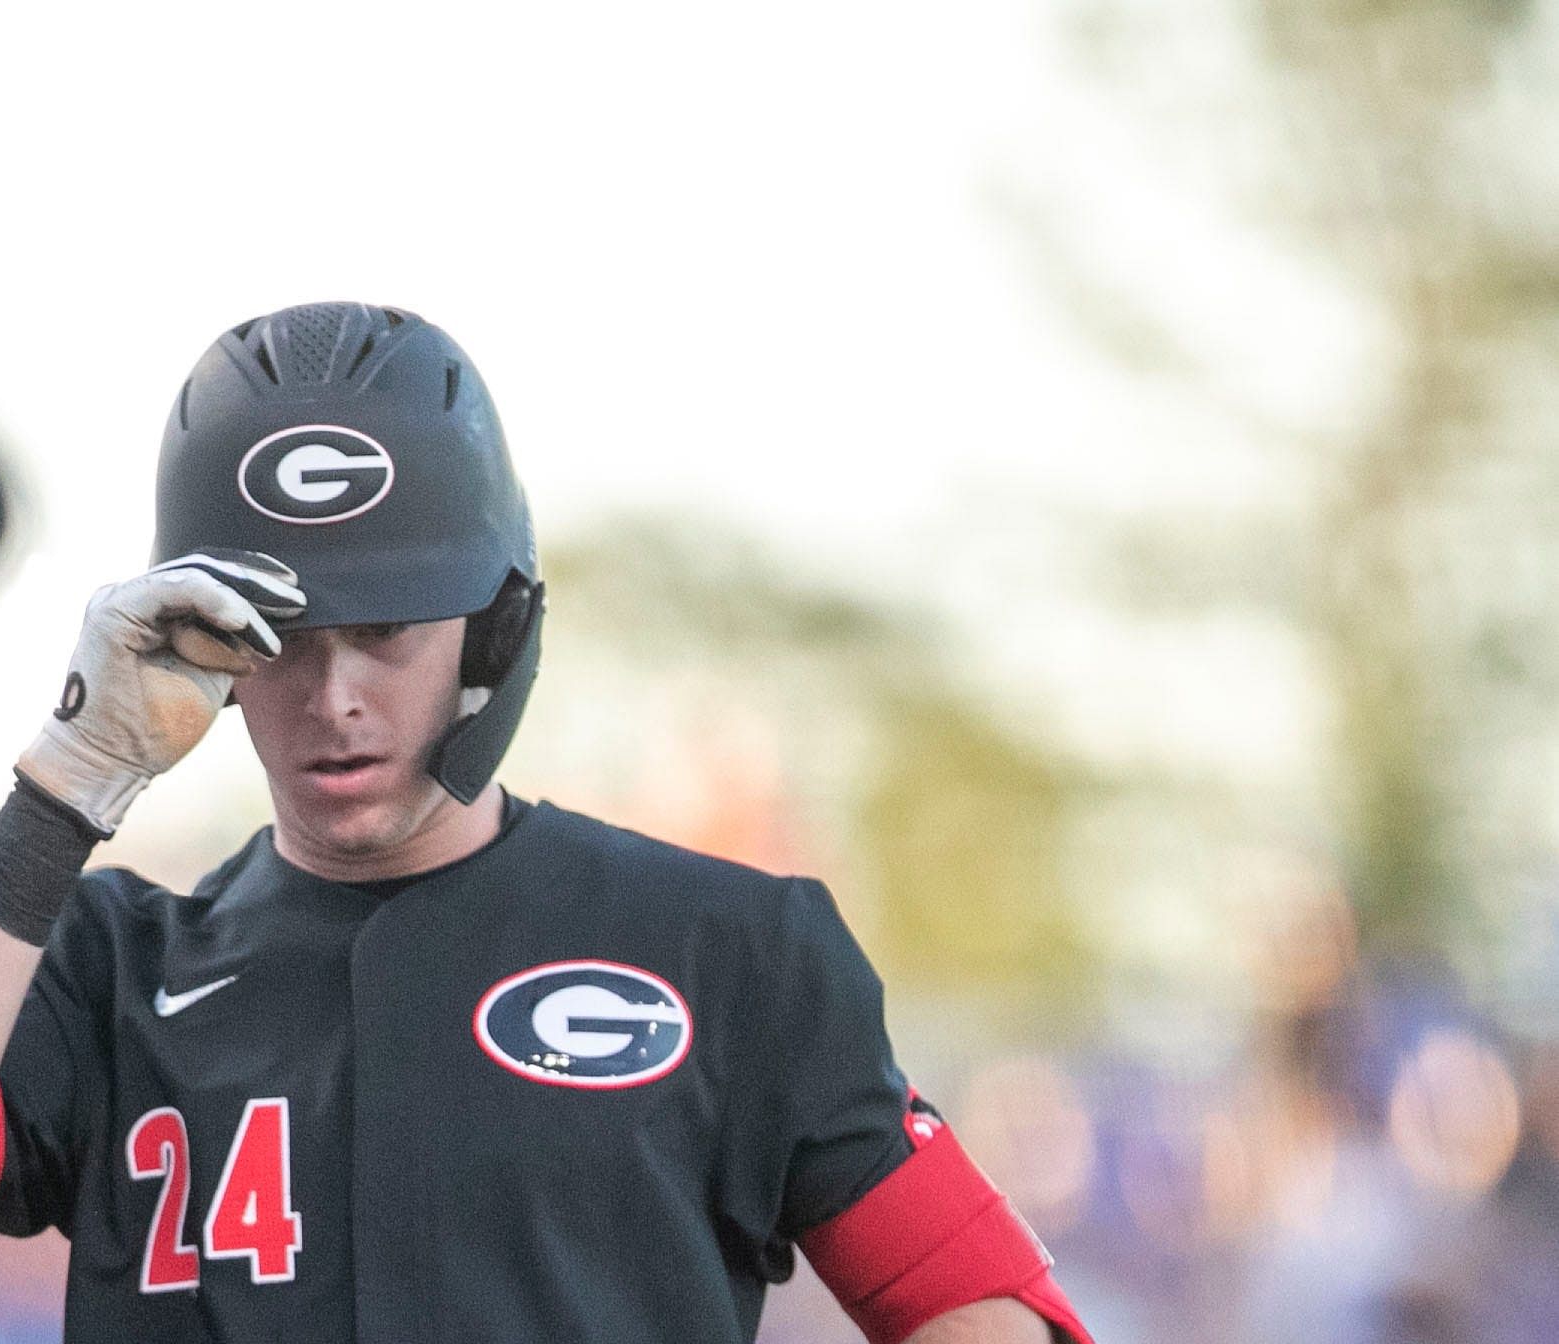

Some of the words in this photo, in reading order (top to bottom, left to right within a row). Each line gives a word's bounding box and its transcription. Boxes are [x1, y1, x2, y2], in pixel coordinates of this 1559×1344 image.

[276, 443, 391, 503] G
[532, 984, 684, 1059] G
[126, 1096, 302, 1293] 24
